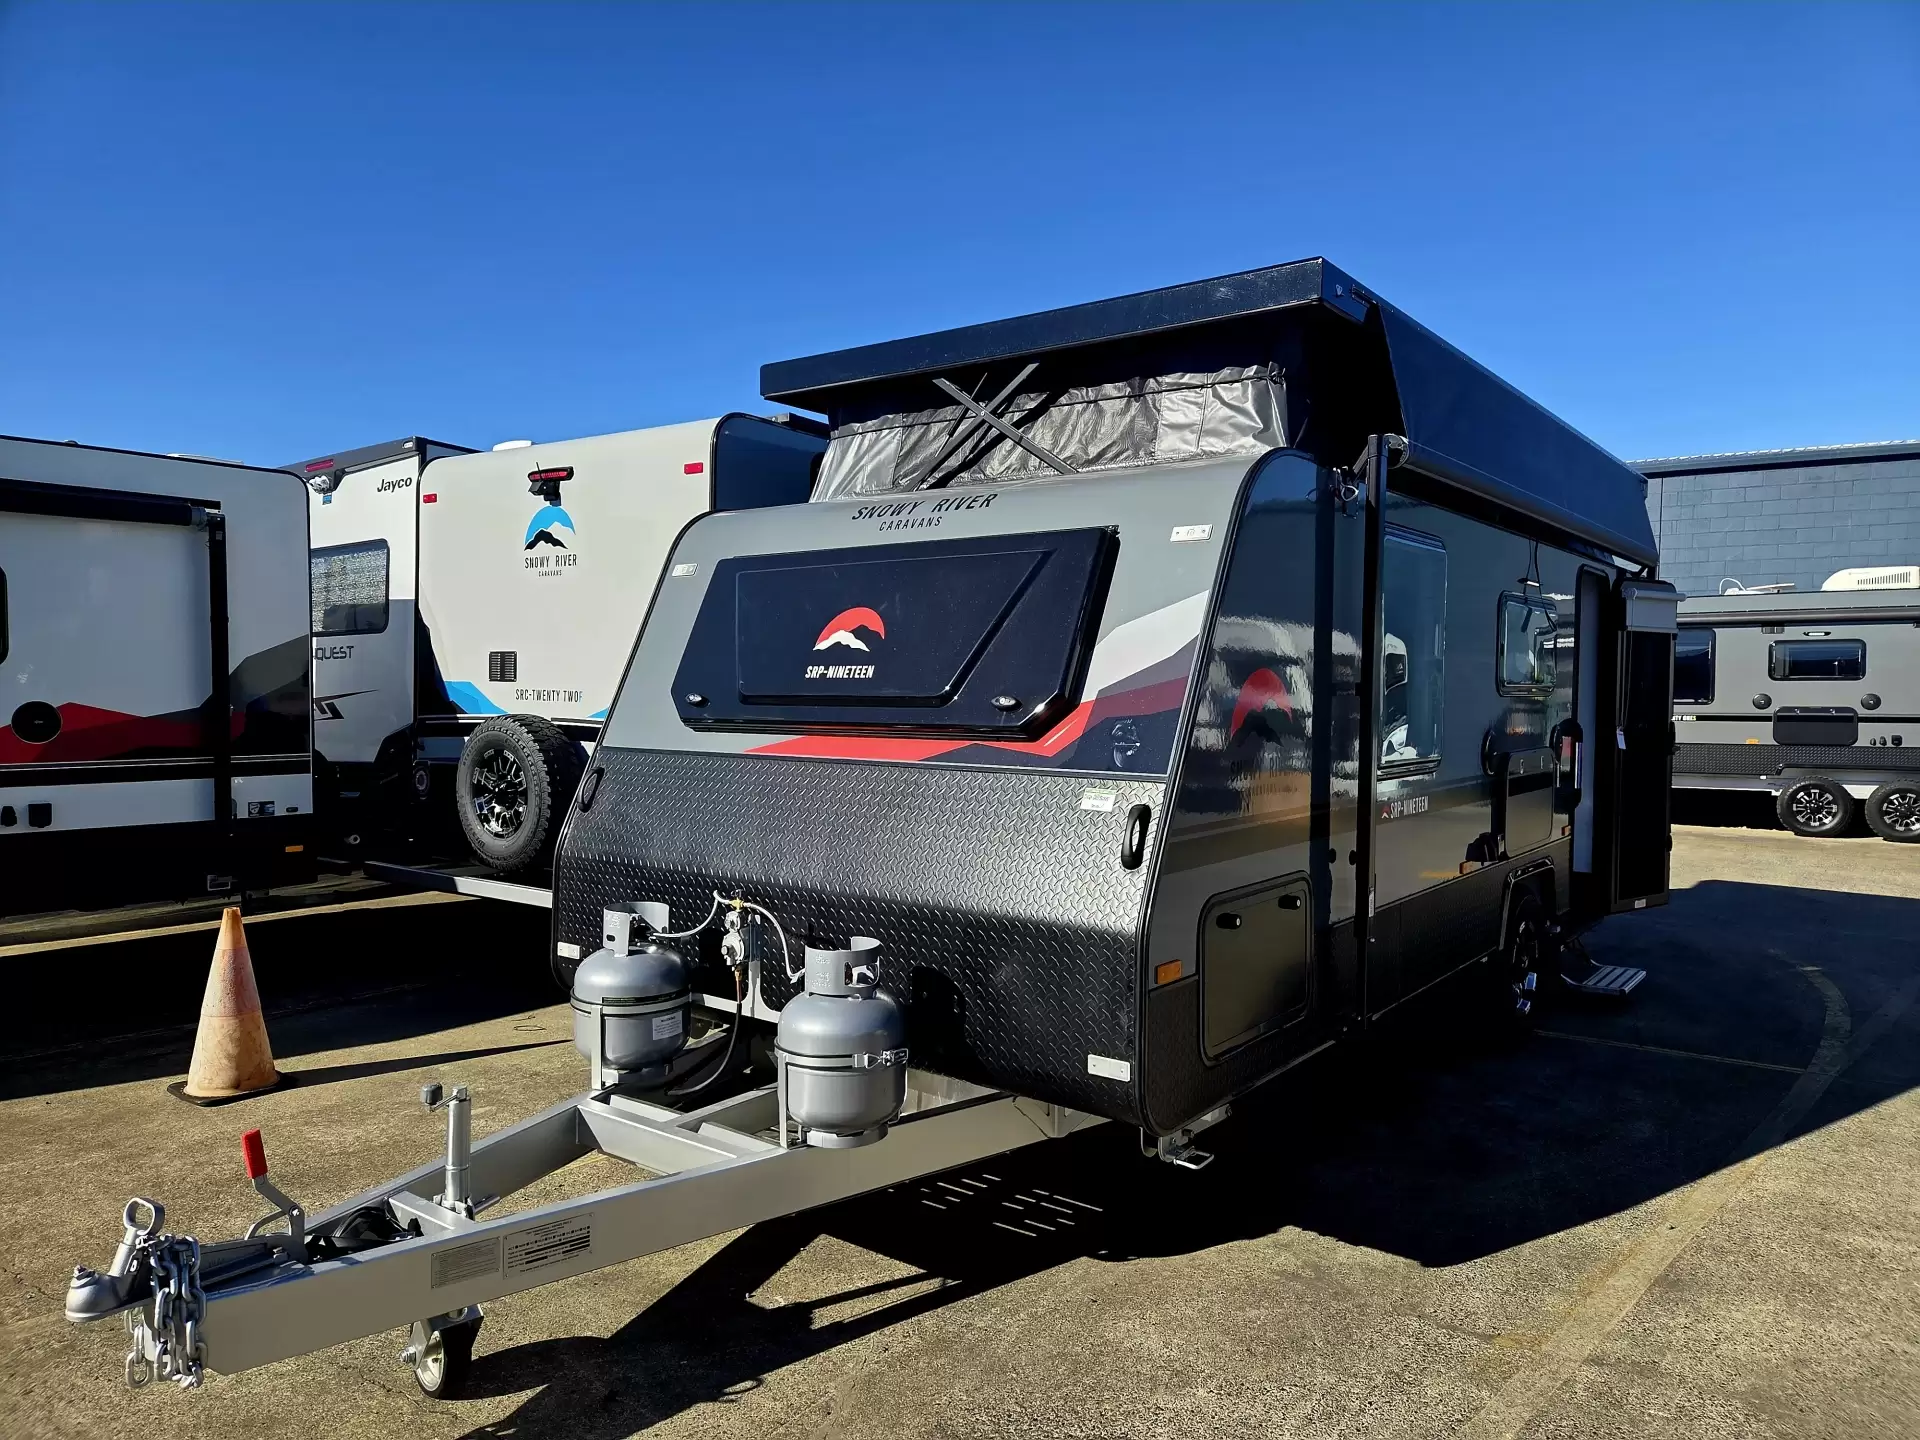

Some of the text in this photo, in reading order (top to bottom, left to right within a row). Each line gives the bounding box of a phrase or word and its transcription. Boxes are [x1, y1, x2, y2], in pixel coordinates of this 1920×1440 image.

[377, 477, 412, 492] Jayco
[852, 493, 998, 520] SNOWY RIVER
[879, 516, 943, 531] CARAVANS
[524, 553, 577, 569] SNOWY RIVER
[538, 569, 562, 577] CARAVANS
[805, 665, 875, 679] SRP-NINETEEN
[515, 688, 560, 702] SRC-TWENTY
